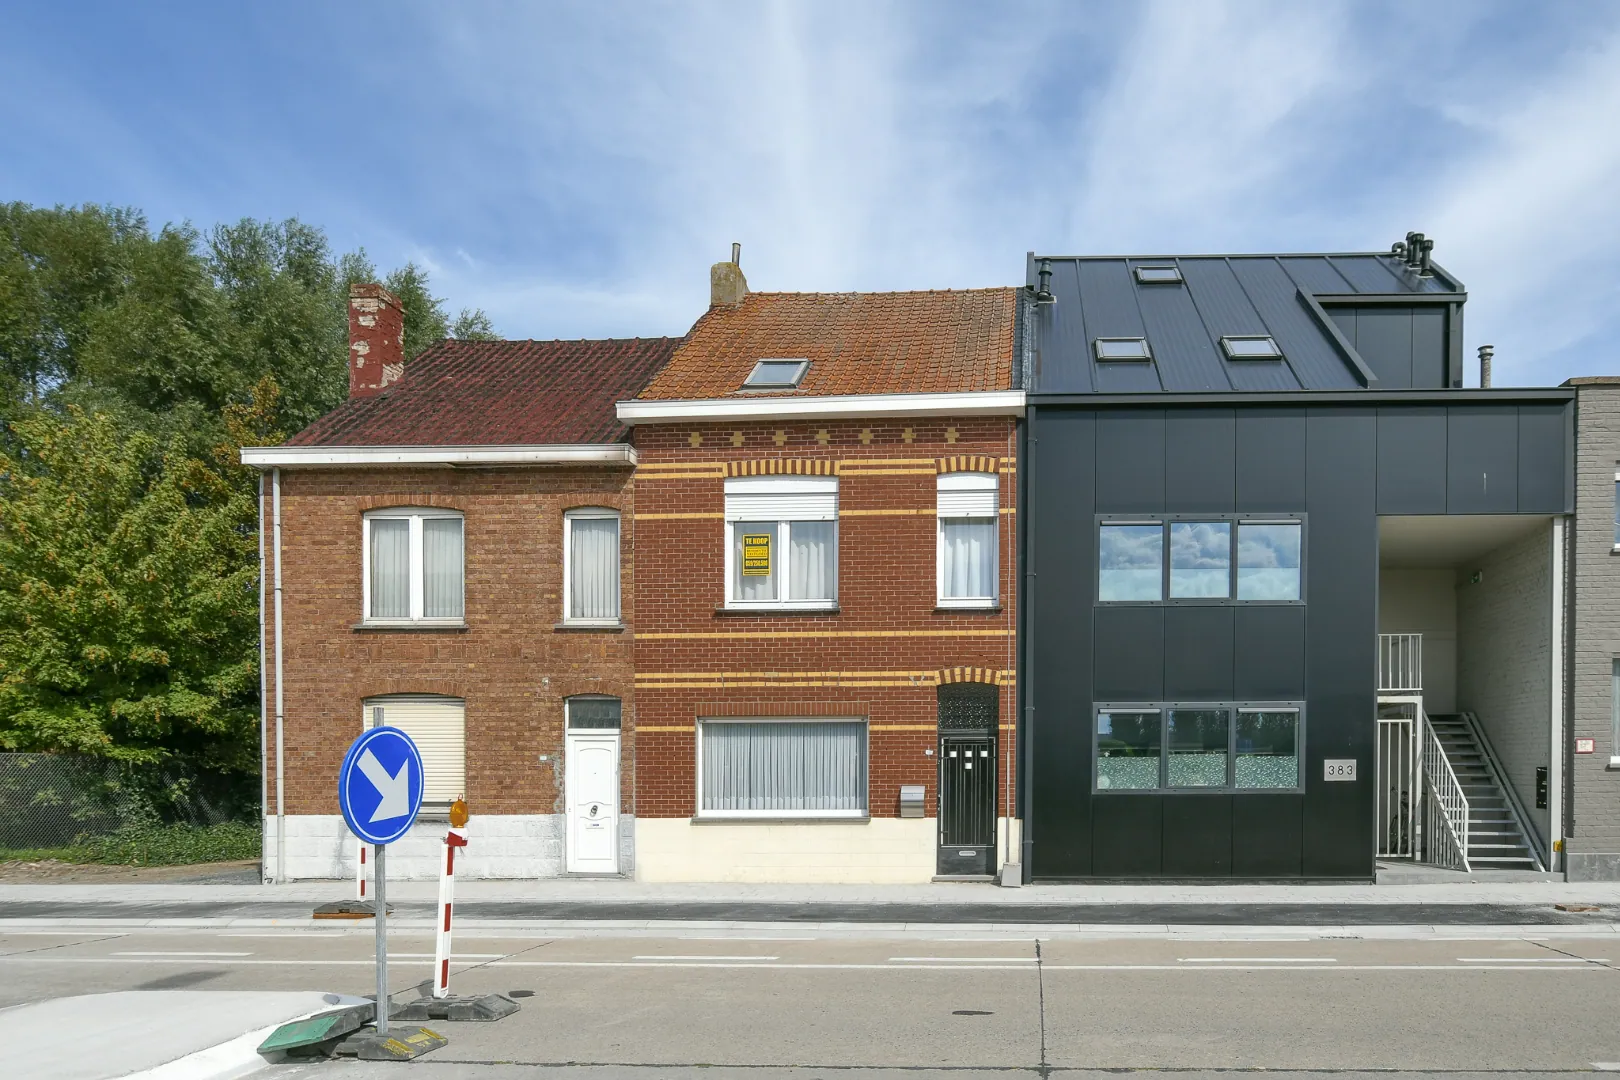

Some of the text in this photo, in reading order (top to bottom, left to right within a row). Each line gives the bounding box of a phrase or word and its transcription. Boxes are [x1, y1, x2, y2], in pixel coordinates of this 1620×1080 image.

[745, 537, 768, 545] TE KOOP
[1328, 765, 1353, 775] 383
